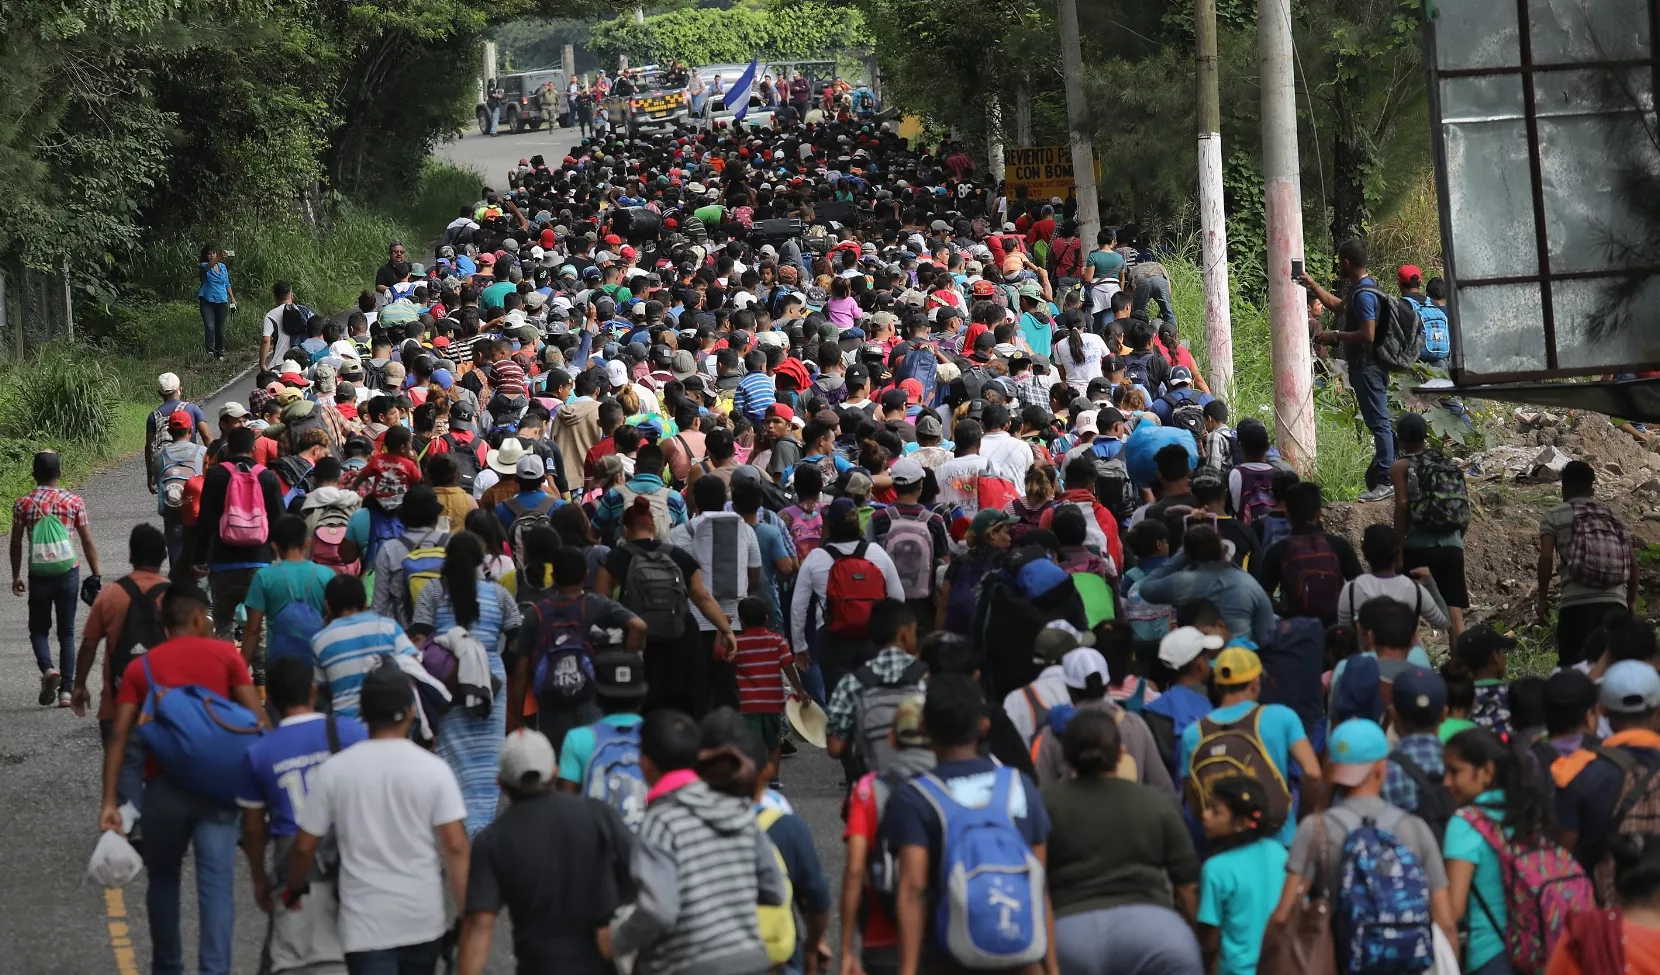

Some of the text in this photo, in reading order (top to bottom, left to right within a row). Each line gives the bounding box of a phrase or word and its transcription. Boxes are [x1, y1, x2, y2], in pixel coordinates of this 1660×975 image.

[1004, 148, 1054, 166] REVIENTO
[1016, 165, 1075, 180] CON BOM
